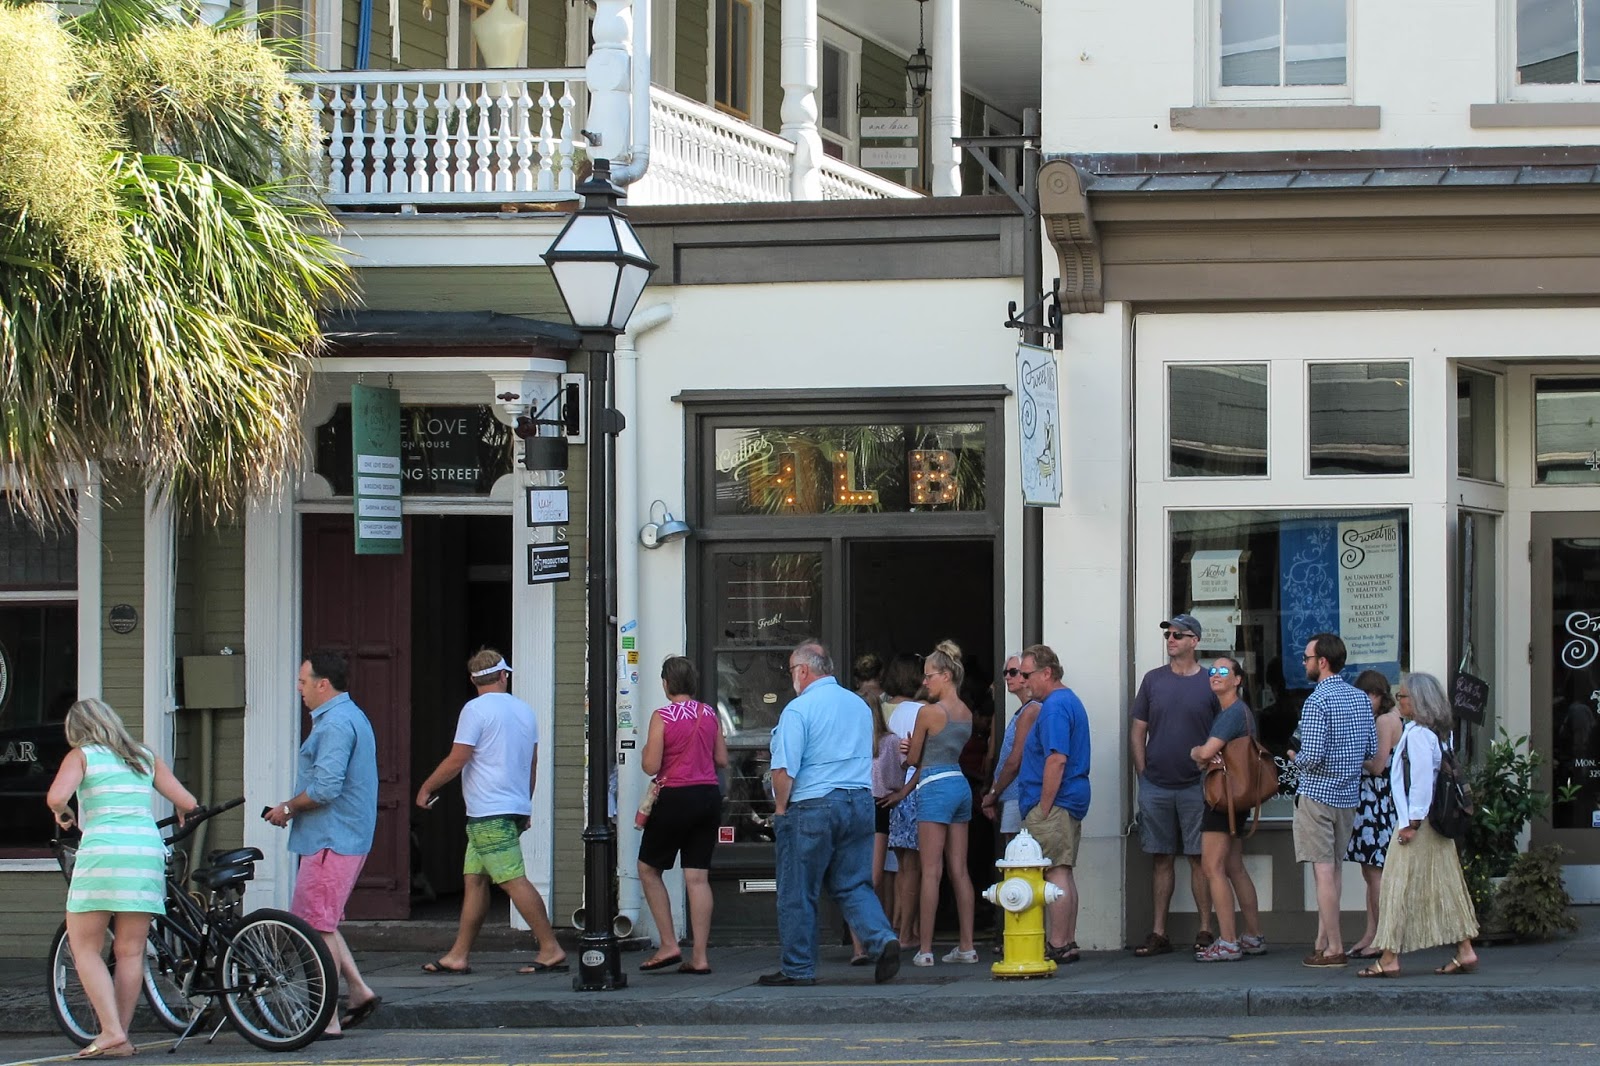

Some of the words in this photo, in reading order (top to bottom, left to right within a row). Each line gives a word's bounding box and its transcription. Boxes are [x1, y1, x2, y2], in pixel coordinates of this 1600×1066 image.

[416, 418, 467, 435] LOVE
[430, 467, 480, 480] STREET
[1340, 524, 1392, 569] Sweet
[757, 612, 782, 629] Fresh!
[1348, 616, 1382, 624] PRINCIPLES
